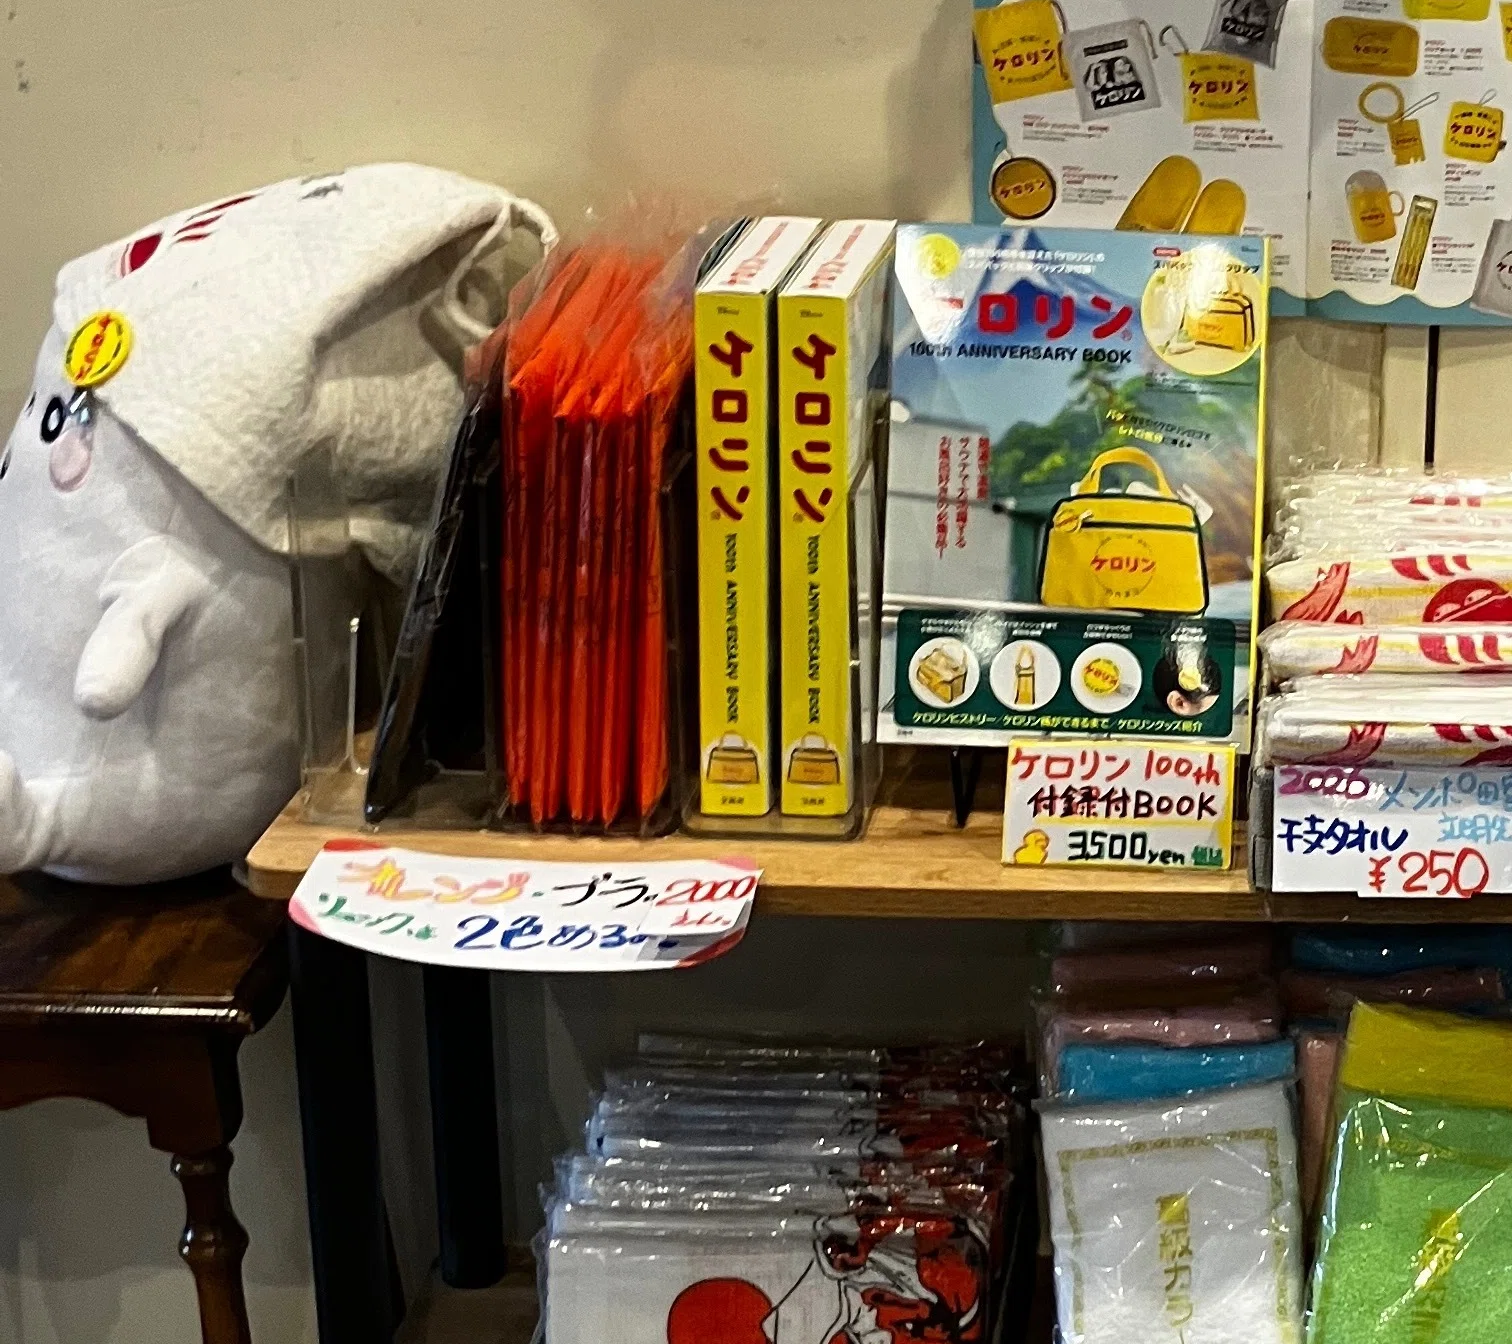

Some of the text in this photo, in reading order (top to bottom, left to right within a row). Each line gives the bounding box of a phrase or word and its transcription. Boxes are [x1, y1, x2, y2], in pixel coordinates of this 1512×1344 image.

[1188, 78, 1250, 95] ケロリン
[1450, 121, 1498, 140] ケロリン
[942, 292, 1134, 342] ロリン
[956, 342, 1079, 362] ANNIVERSARY
[1081, 346, 1133, 364] BOOK
[708, 330, 754, 523] ケロリン
[791, 333, 838, 524] ケロリン
[1090, 555, 1157, 573] ケロリン
[1010, 747, 1223, 787] ケロリン 100th
[1027, 786, 1220, 820] 付録付BOOK
[1277, 813, 1410, 855] 干支タオル
[1367, 847, 1490, 896] ¥250
